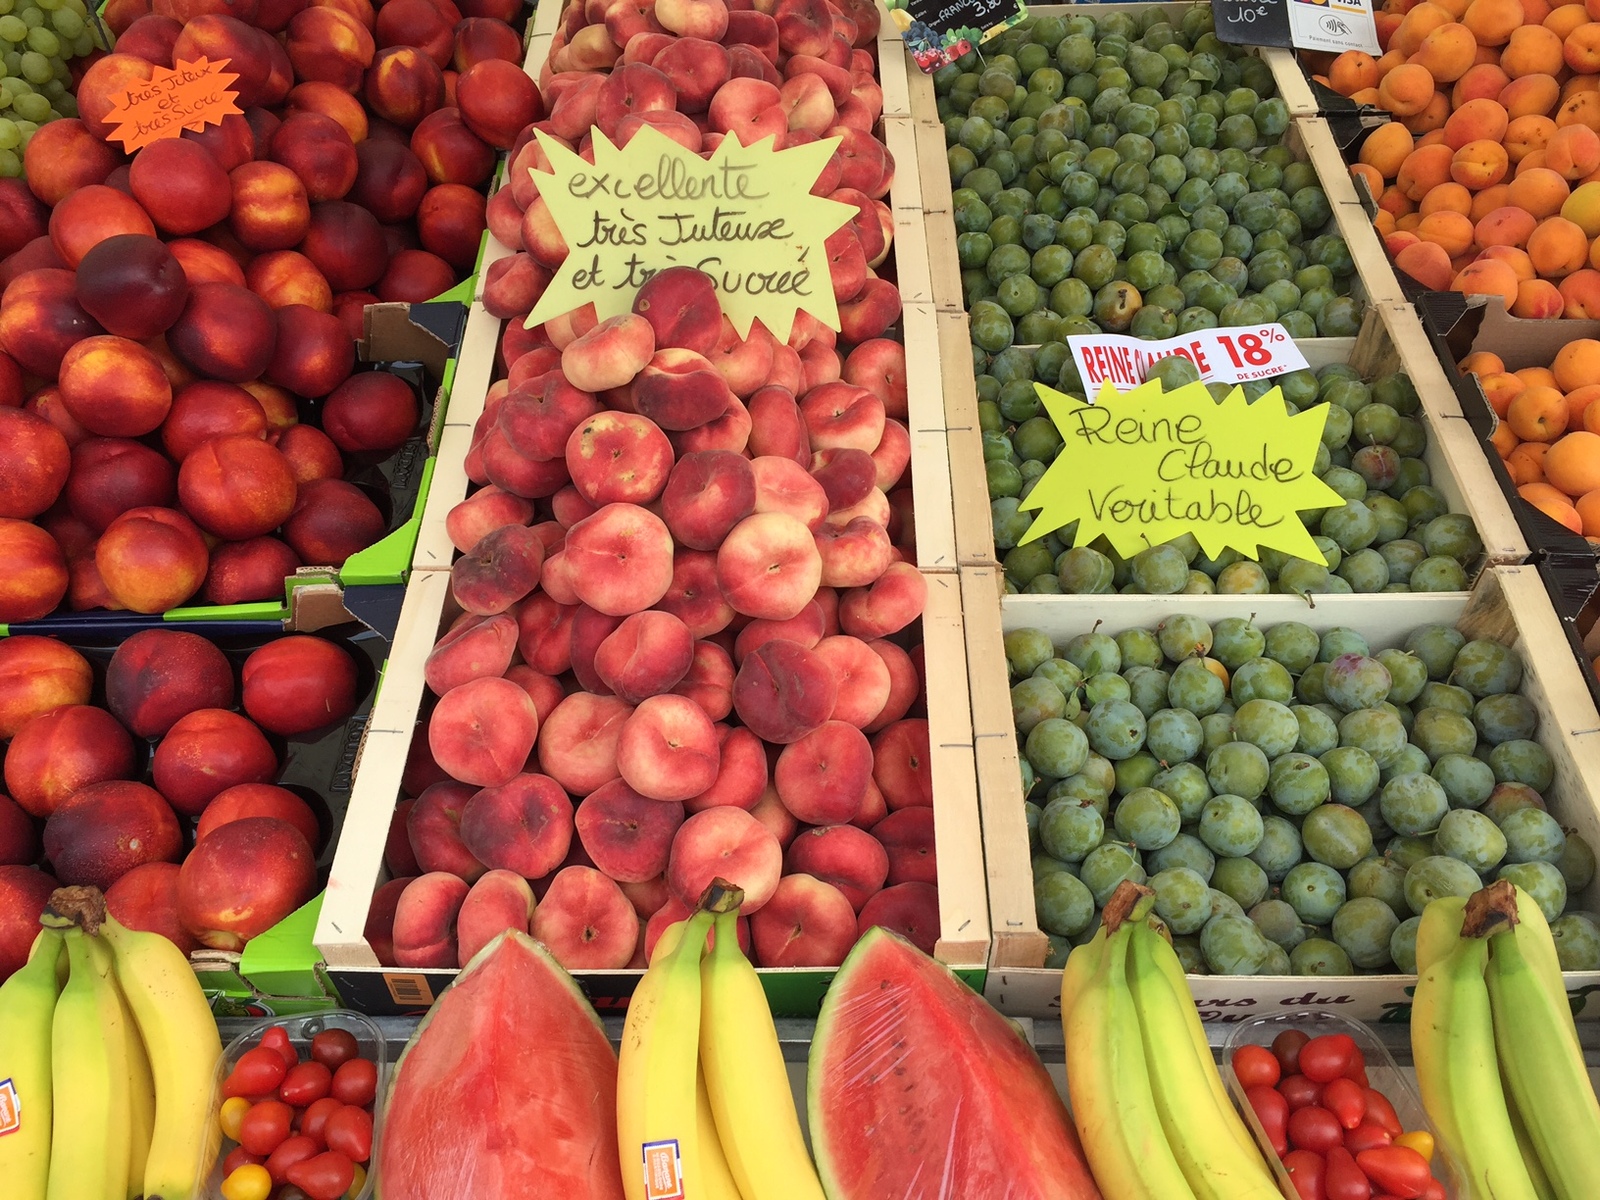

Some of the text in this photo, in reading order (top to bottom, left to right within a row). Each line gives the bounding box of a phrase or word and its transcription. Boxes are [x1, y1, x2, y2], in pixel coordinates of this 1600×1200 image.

[157, 93, 180, 110] et
[568, 153, 770, 200] excellente
[577, 208, 648, 247] très
[571, 254, 606, 290] et
[1080, 345, 1137, 385] REINE
[1216, 327, 1286, 369] 18%
[1236, 373, 1250, 381] DE
[1069, 406, 1207, 445] Reine
[1157, 441, 1304, 483] Claude
